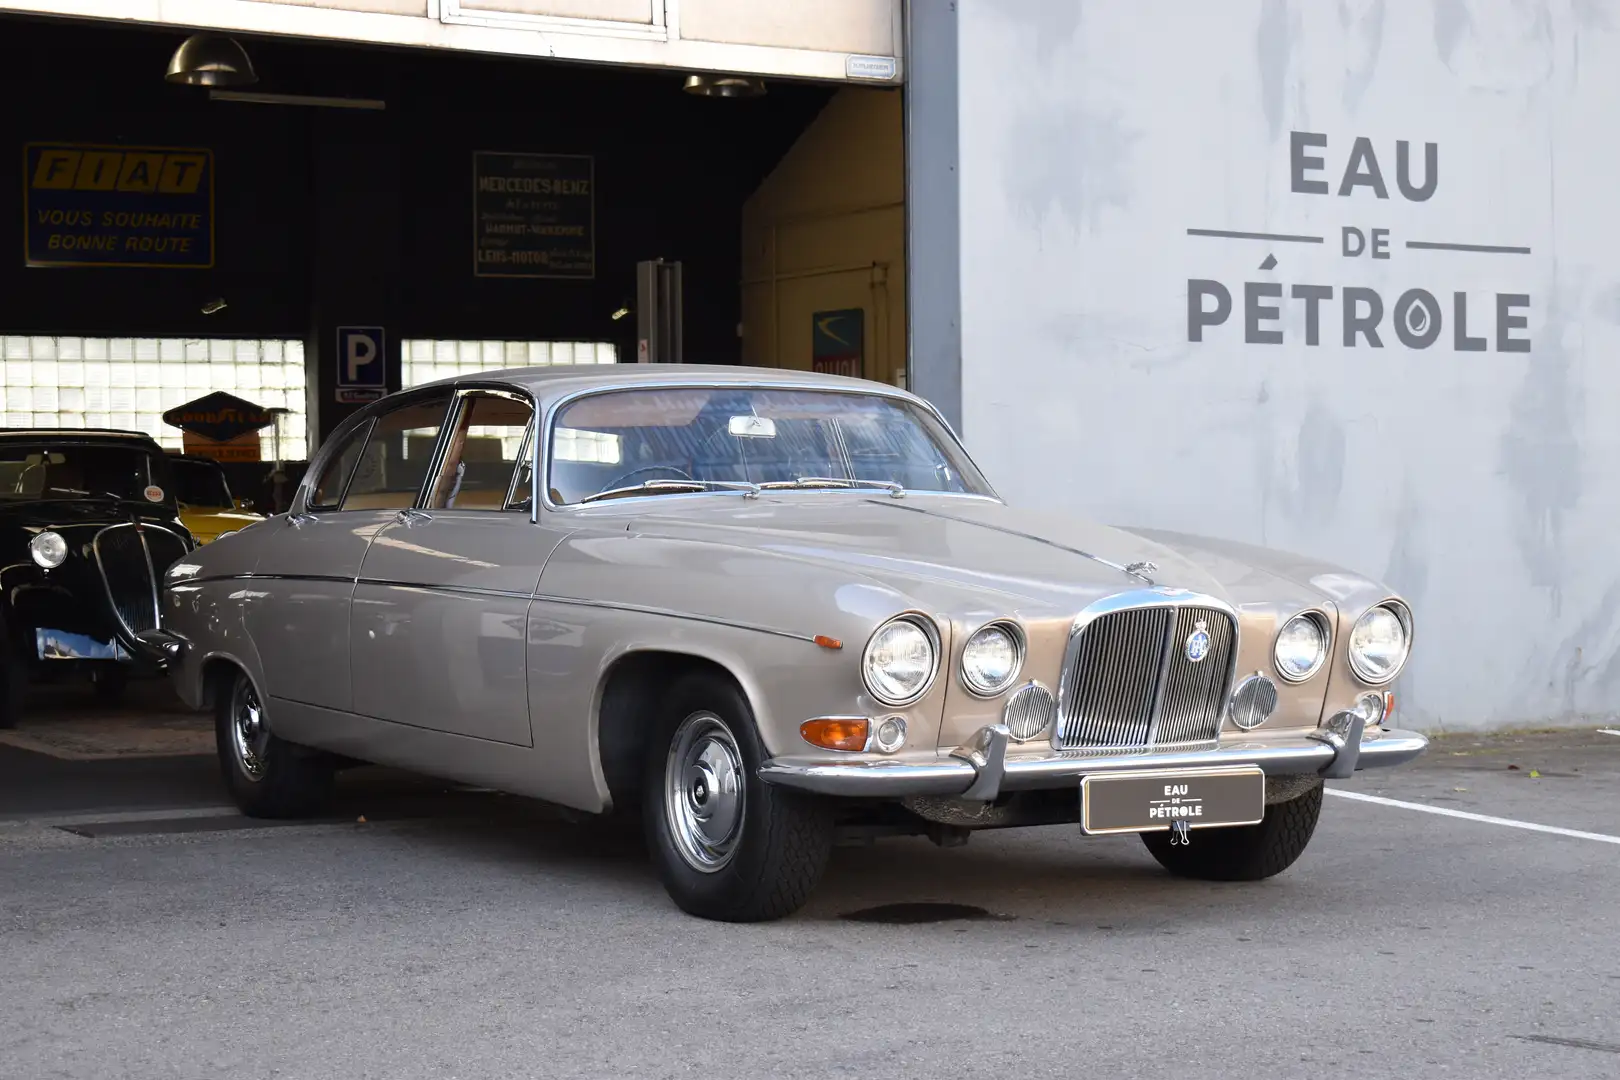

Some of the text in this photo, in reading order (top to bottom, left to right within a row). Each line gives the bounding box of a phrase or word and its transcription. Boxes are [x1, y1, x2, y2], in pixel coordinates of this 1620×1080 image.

[45, 157, 197, 187] FIAT
[1290, 131, 1438, 202] EAU
[37, 209, 202, 229] VOUS SOUHAITE
[47, 233, 193, 253] BONNE ROUTE
[1341, 226, 1391, 259] DE
[1187, 253, 1531, 352] PÉTROLE
[346, 334, 377, 382] P
[1164, 784, 1189, 796] EAU
[1149, 803, 1203, 818] PÉTROLE
